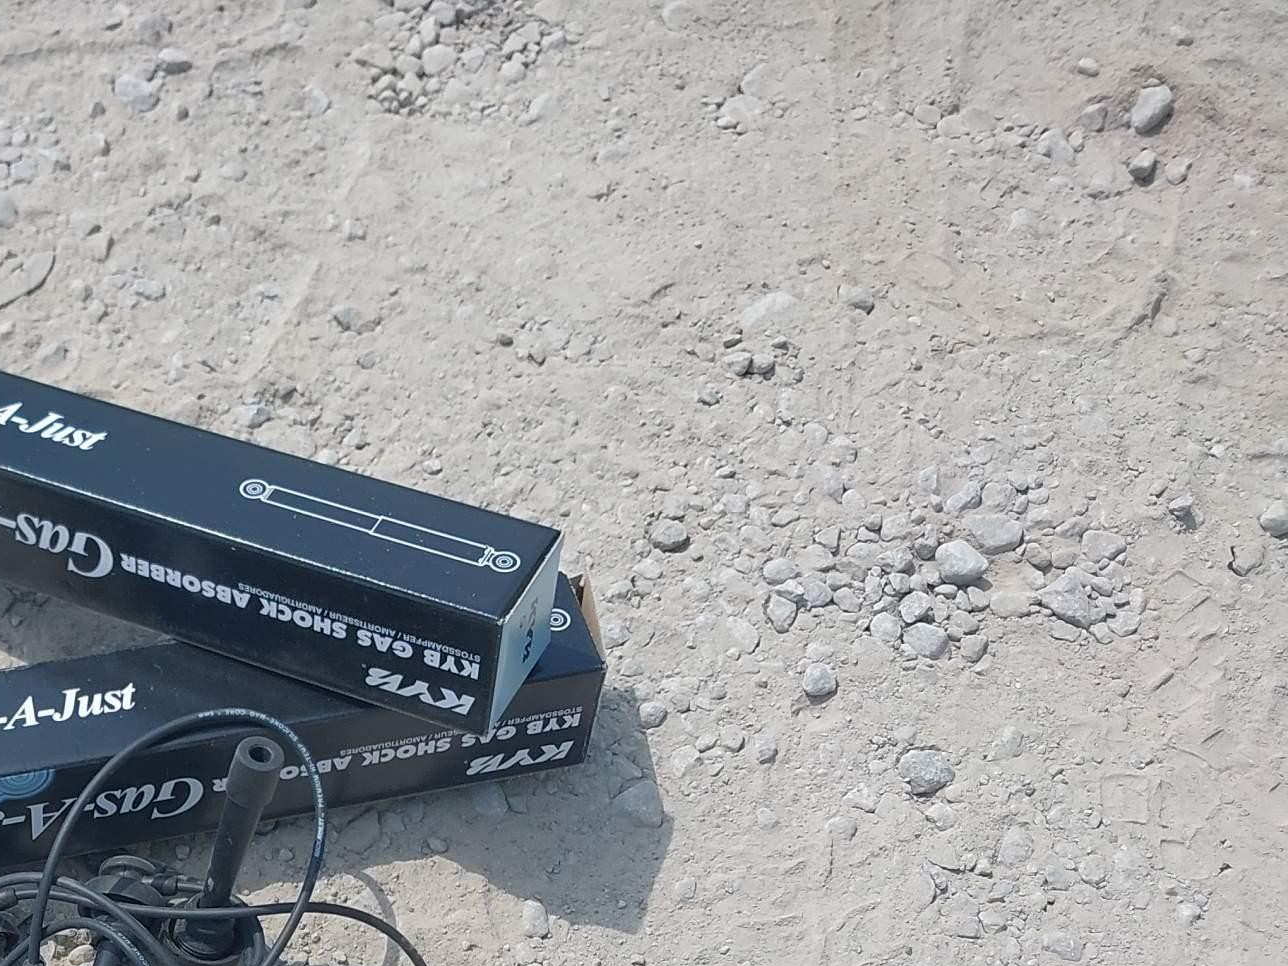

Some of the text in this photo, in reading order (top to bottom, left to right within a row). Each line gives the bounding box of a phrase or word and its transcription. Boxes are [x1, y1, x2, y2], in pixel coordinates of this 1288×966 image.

[119, 553, 251, 609] ABSORBER
[259, 597, 348, 640] SHOCK
[357, 628, 414, 658] GAS
[423, 650, 480, 680] KYB
[365, 666, 476, 715] KYB
[526, 713, 581, 736] KYB
[361, 737, 452, 767] SHOCK
[467, 740, 575, 776] KYB
